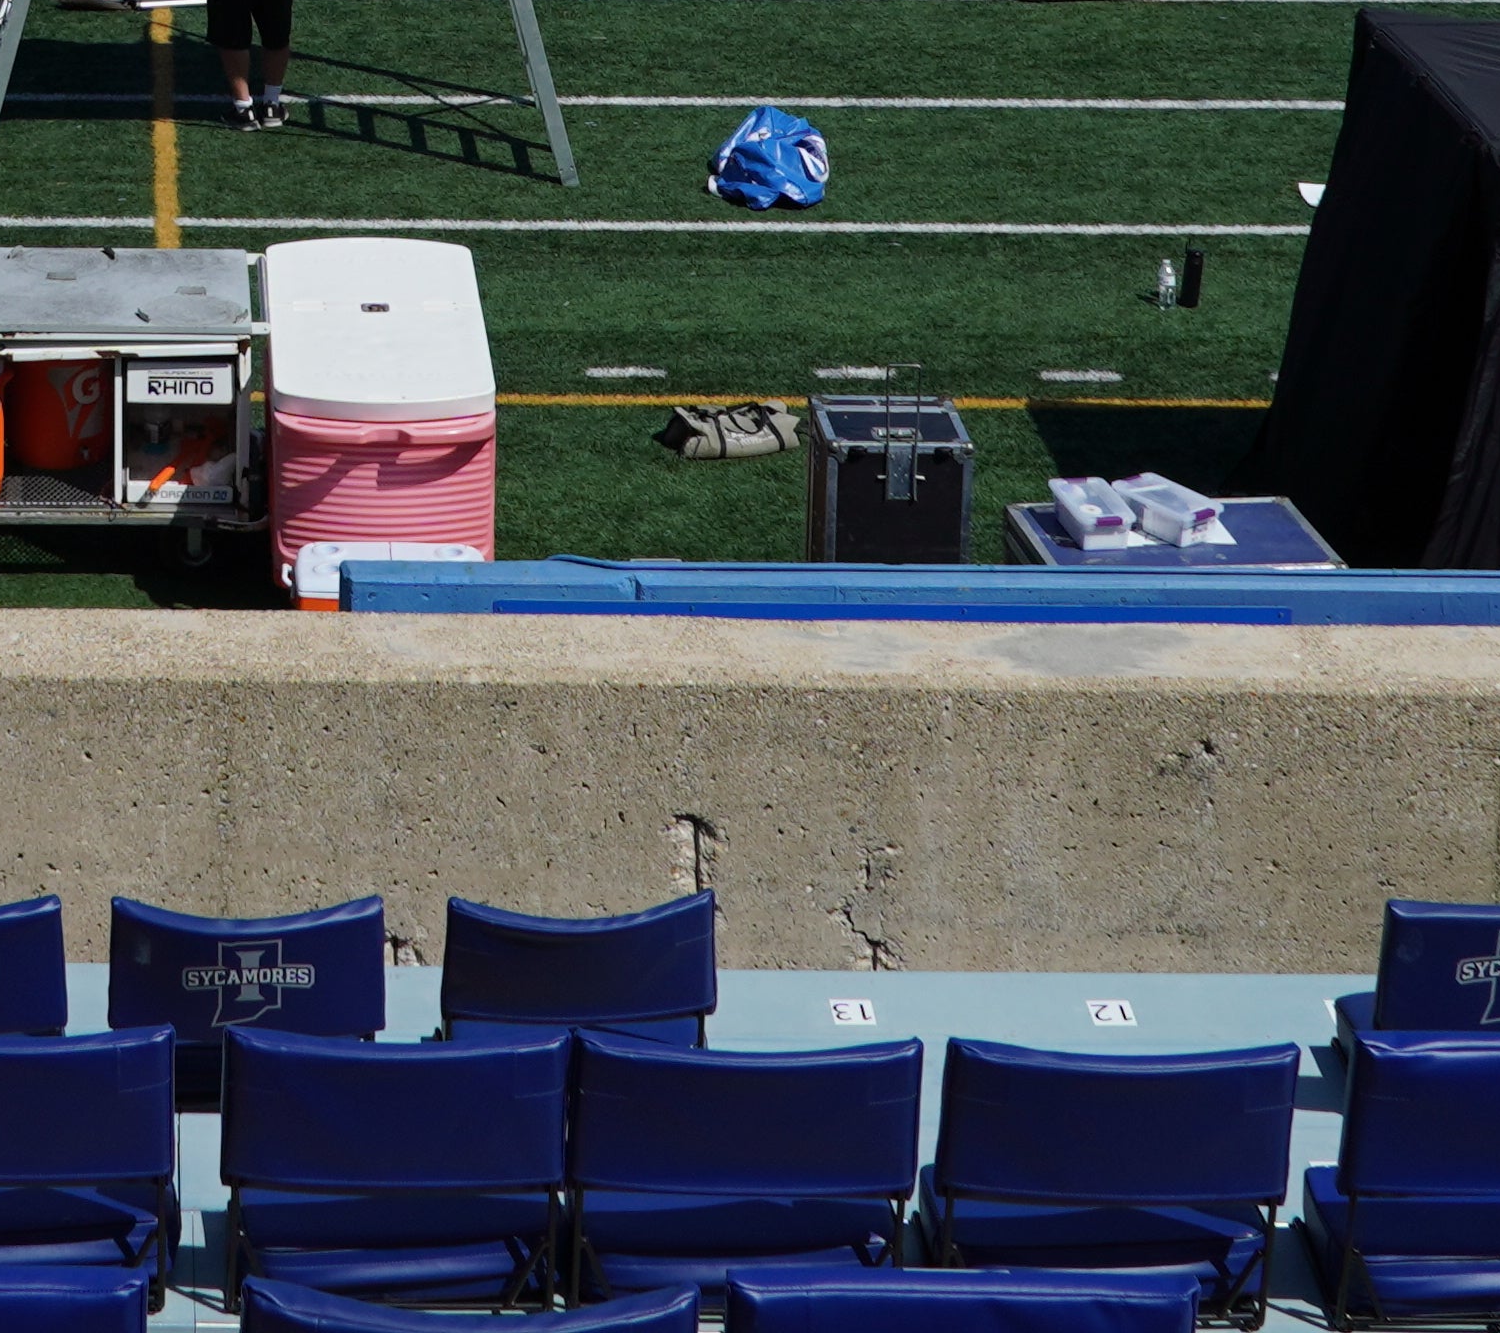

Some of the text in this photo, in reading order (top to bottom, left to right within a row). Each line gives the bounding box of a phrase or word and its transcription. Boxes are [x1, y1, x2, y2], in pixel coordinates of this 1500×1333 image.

[71, 367, 100, 405] G
[148, 380, 213, 395] RHINO
[144, 489, 211, 499] HYDRATION
[187, 965, 311, 987] SYCAMORES
[833, 1004, 872, 1021] 13
[1091, 1004, 1132, 1021] 12
